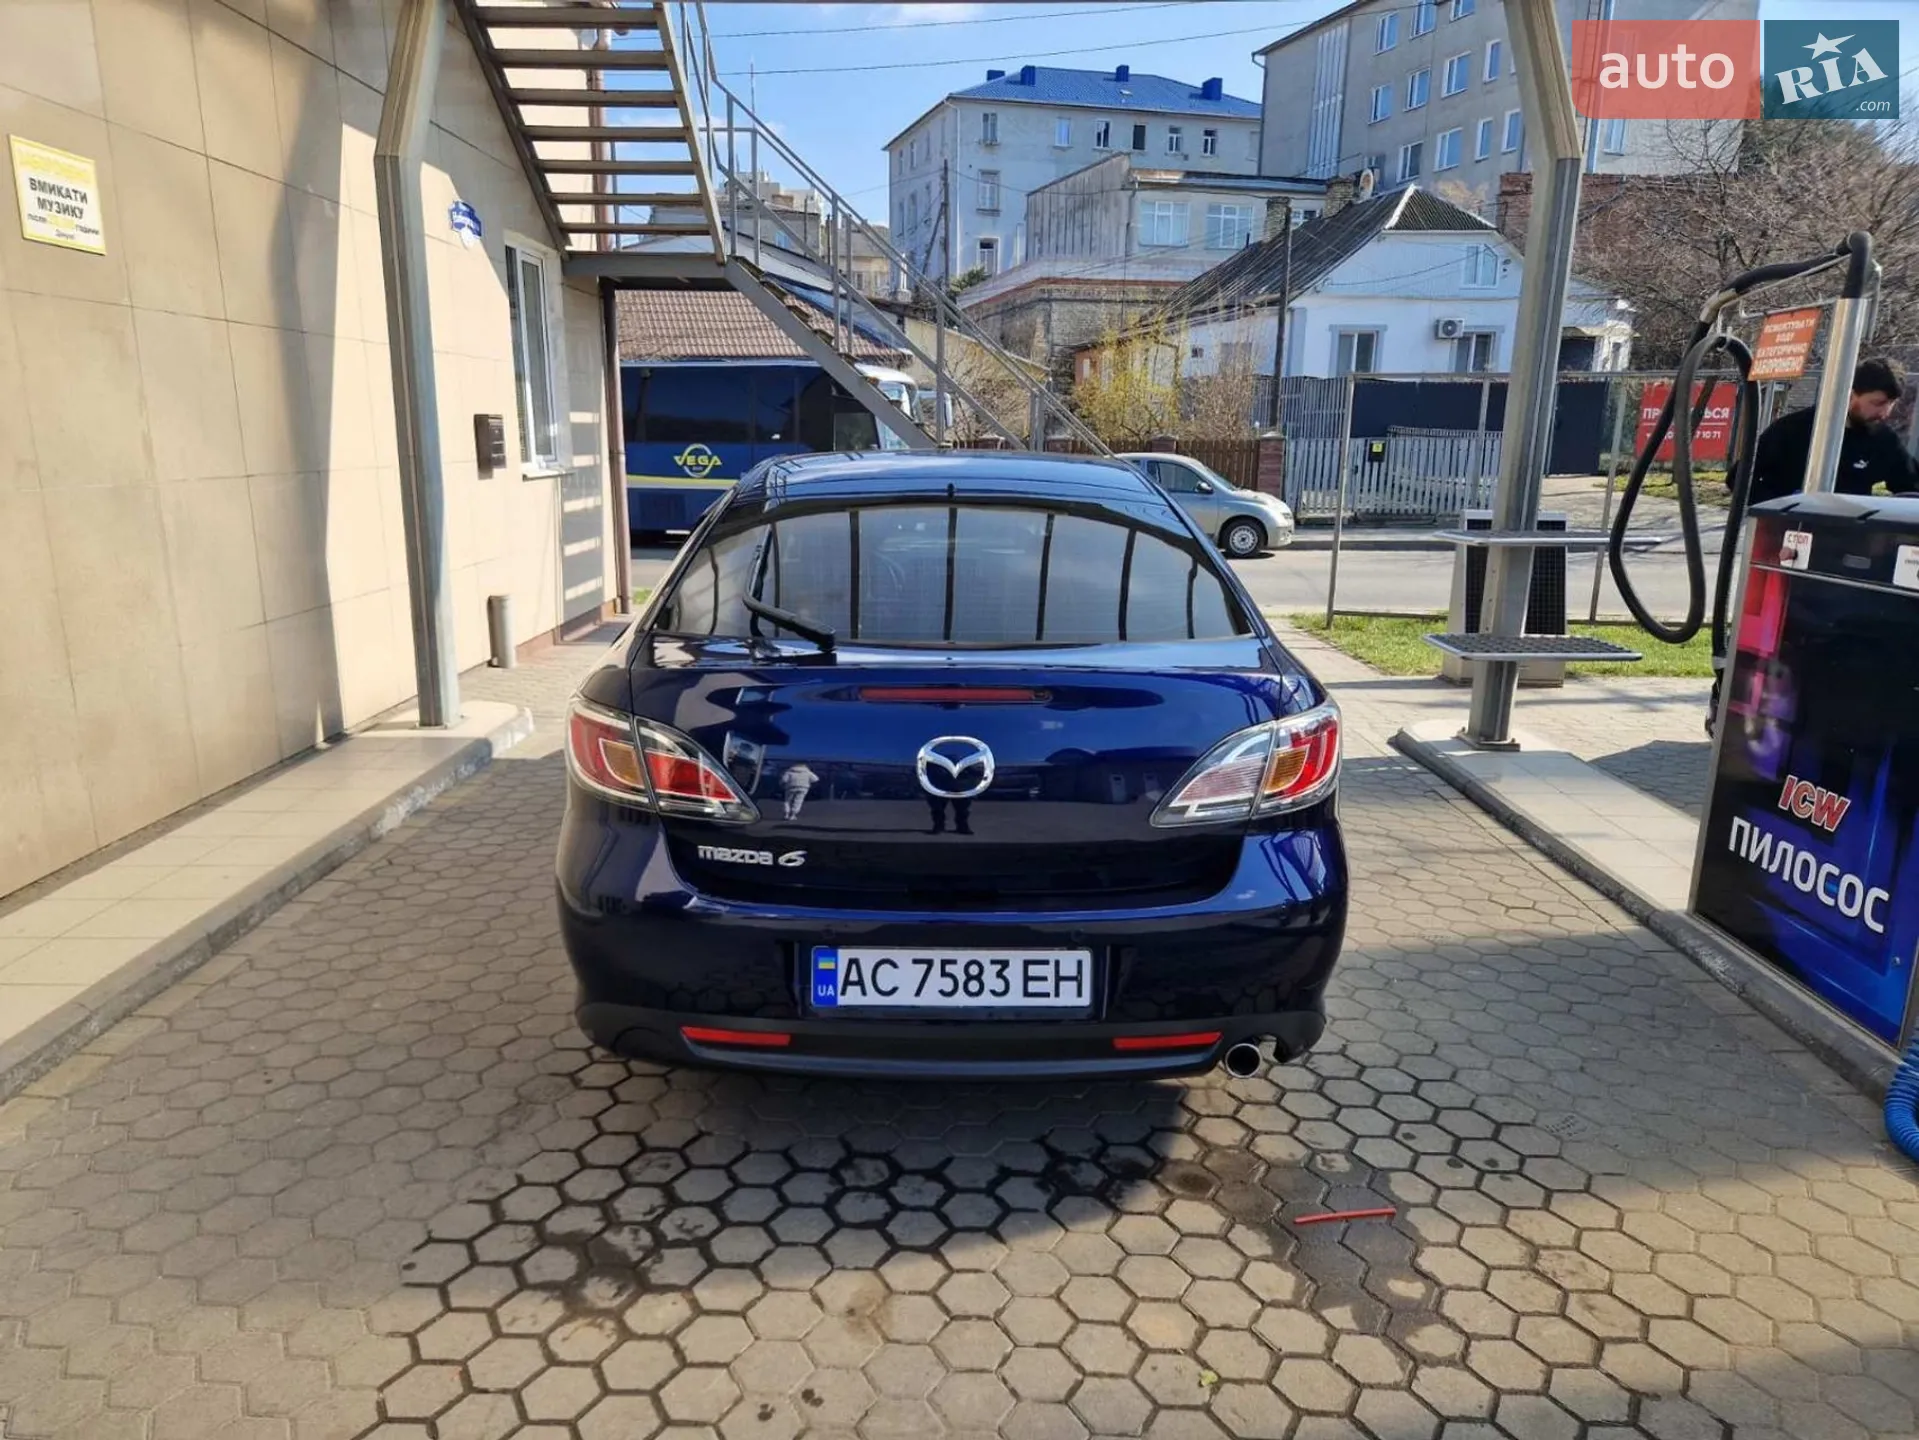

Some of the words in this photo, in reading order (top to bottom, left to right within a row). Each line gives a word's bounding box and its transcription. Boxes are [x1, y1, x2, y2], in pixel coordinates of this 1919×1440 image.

[29, 177, 88, 205] ВМИКАТИ
[37, 196, 84, 220] МУЗИКУ
[673, 455, 723, 466] VEGA
[1778, 774, 1852, 833] ICW
[778, 850, 808, 867] 6
[1728, 816, 1889, 934] ПИЛОСОС
[817, 984, 835, 997] UA
[840, 957, 900, 997] AC
[911, 959, 1011, 998] 7583
[1022, 959, 1083, 998] EH
